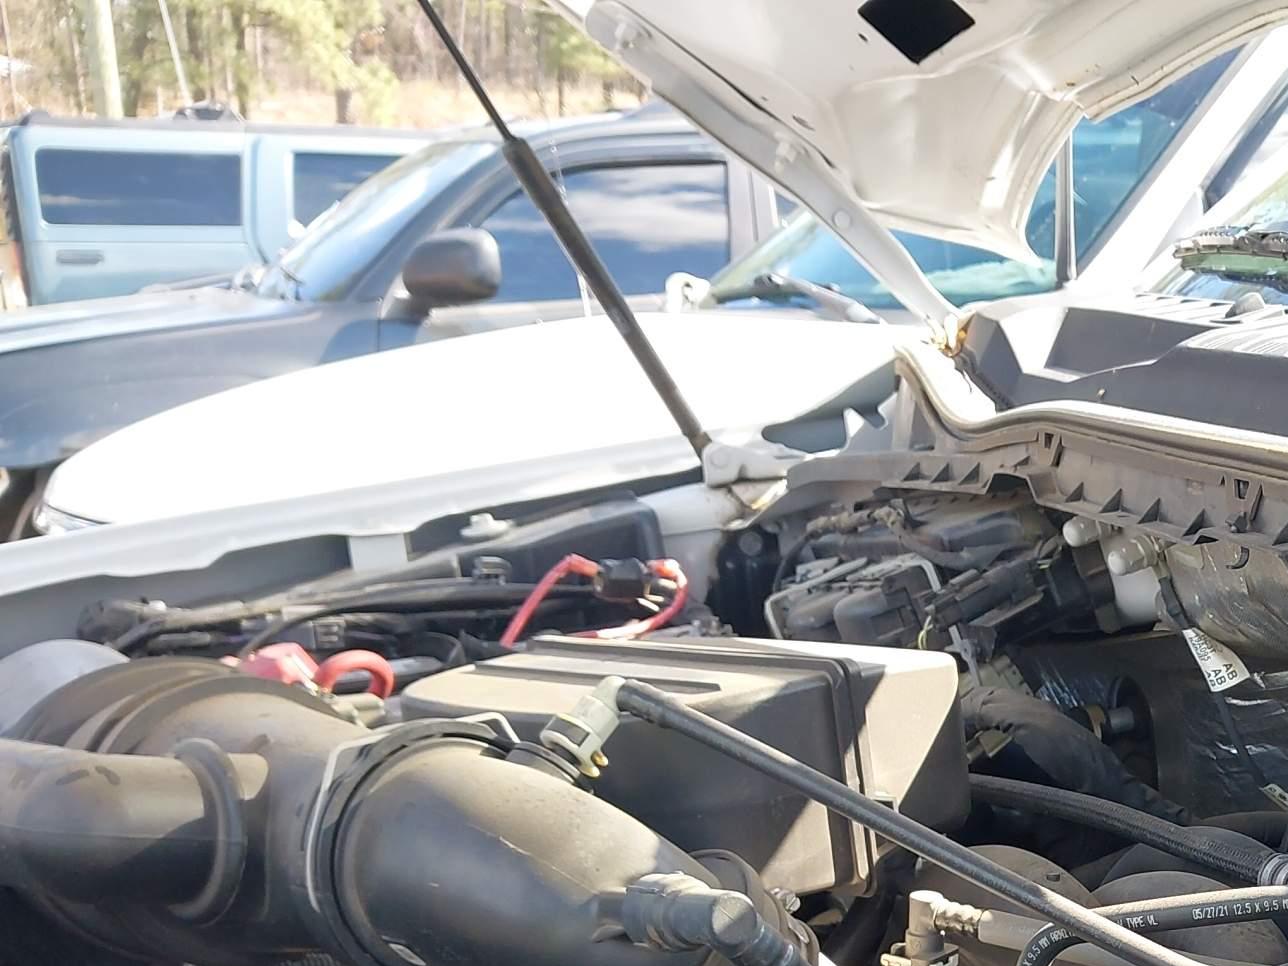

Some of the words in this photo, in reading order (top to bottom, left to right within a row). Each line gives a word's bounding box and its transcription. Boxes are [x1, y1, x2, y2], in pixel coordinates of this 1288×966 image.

[1211, 669, 1226, 685] AB
[1222, 663, 1237, 680] AB
[1192, 906, 1229, 920] 05/27/21
[1233, 902, 1251, 916] 12.5
[1255, 902, 1262, 913] X
[1264, 900, 1279, 912] 9.5
[1126, 916, 1145, 928] TYPE
[1147, 914, 1159, 926] VL
[1027, 945, 1041, 961] 9.5
